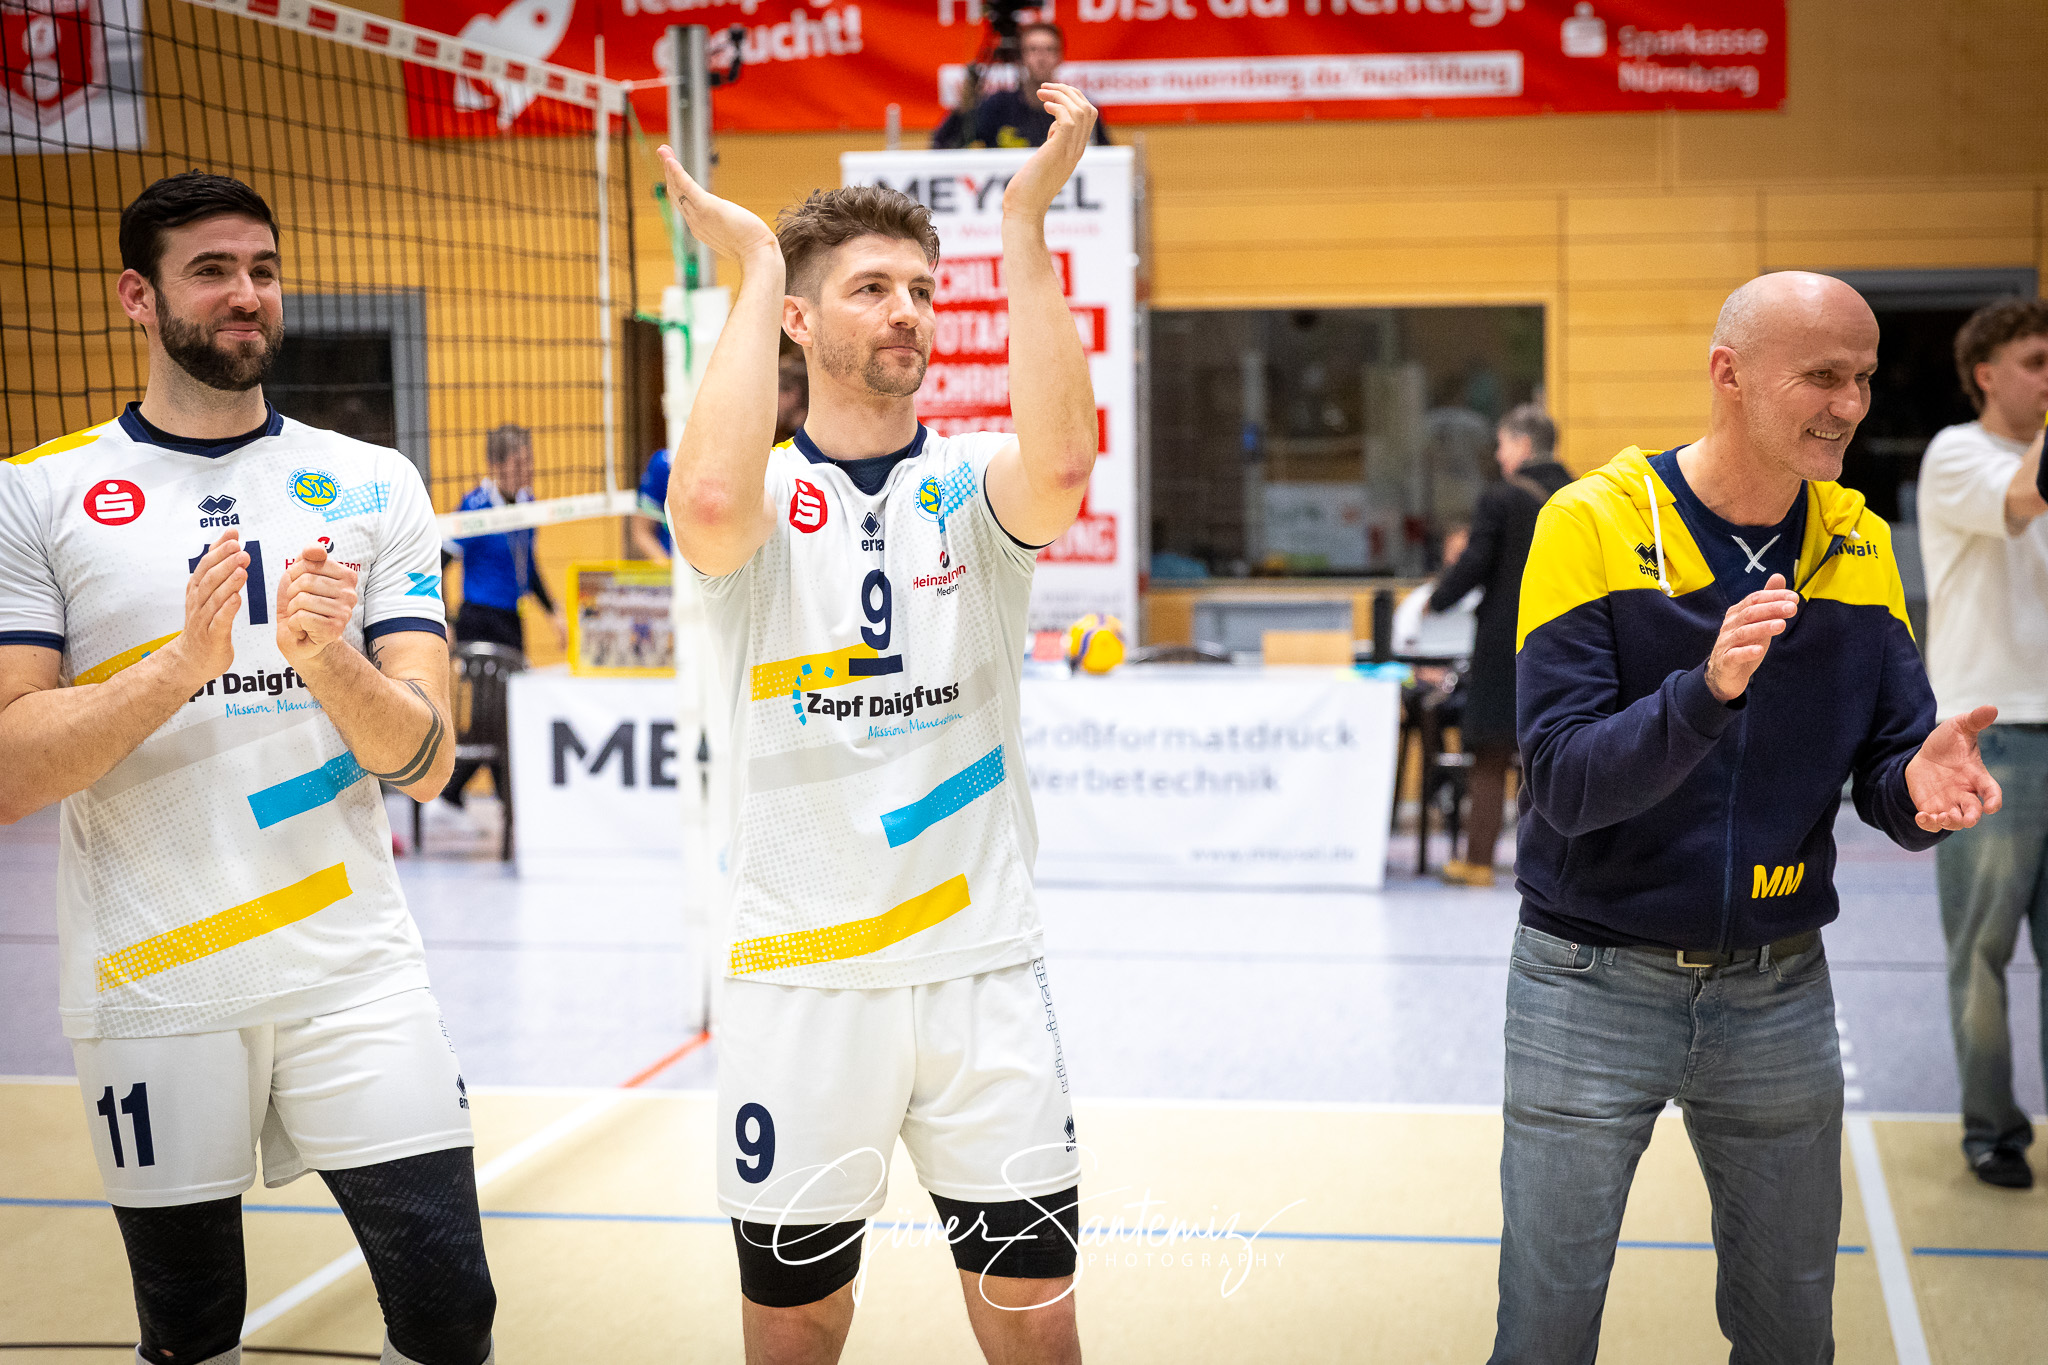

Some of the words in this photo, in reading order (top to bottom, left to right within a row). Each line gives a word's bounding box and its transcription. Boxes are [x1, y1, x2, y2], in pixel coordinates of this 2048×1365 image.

[200, 513, 240, 528] errea
[188, 540, 269, 625] 1
[1639, 563, 1660, 581] erre
[860, 568, 892, 650] 9
[222, 666, 309, 696] Daigfu
[806, 692, 864, 721] Zapf
[869, 682, 960, 718] Daigfuss
[1751, 862, 1805, 899] MM
[96, 1082, 156, 1169] 11
[735, 1102, 776, 1184] 9
